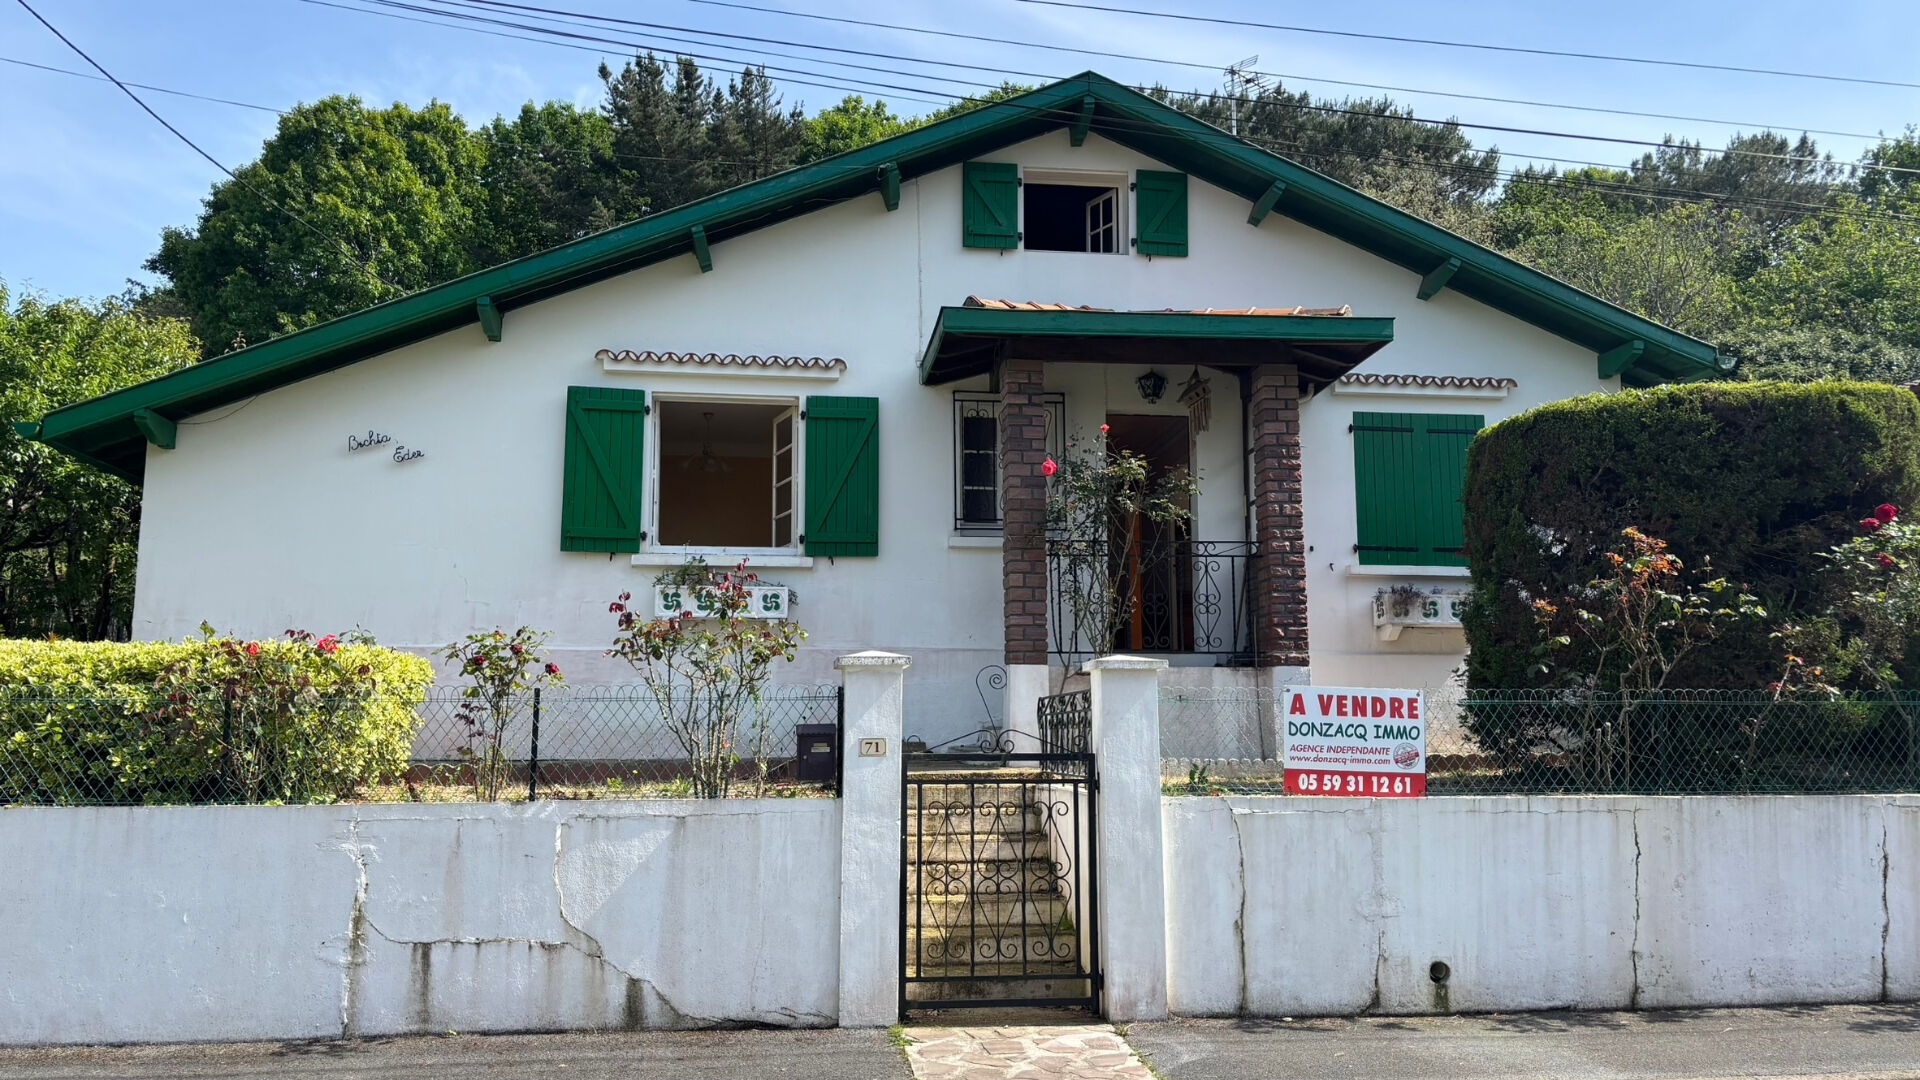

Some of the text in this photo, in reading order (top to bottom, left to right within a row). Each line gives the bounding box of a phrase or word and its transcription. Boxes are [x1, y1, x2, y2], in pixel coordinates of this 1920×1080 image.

[393, 446, 425, 463] Eder
[1289, 693, 1419, 719] A VENDRE
[1288, 721, 1420, 742] DONZACQ IMMO
[865, 742, 879, 753] 71
[1289, 744, 1390, 755] AGENCE INDEPENDANTE
[1289, 754, 1391, 765] www.donzacq-immo.com
[1298, 773, 1411, 793] 05 59 31 12 61
